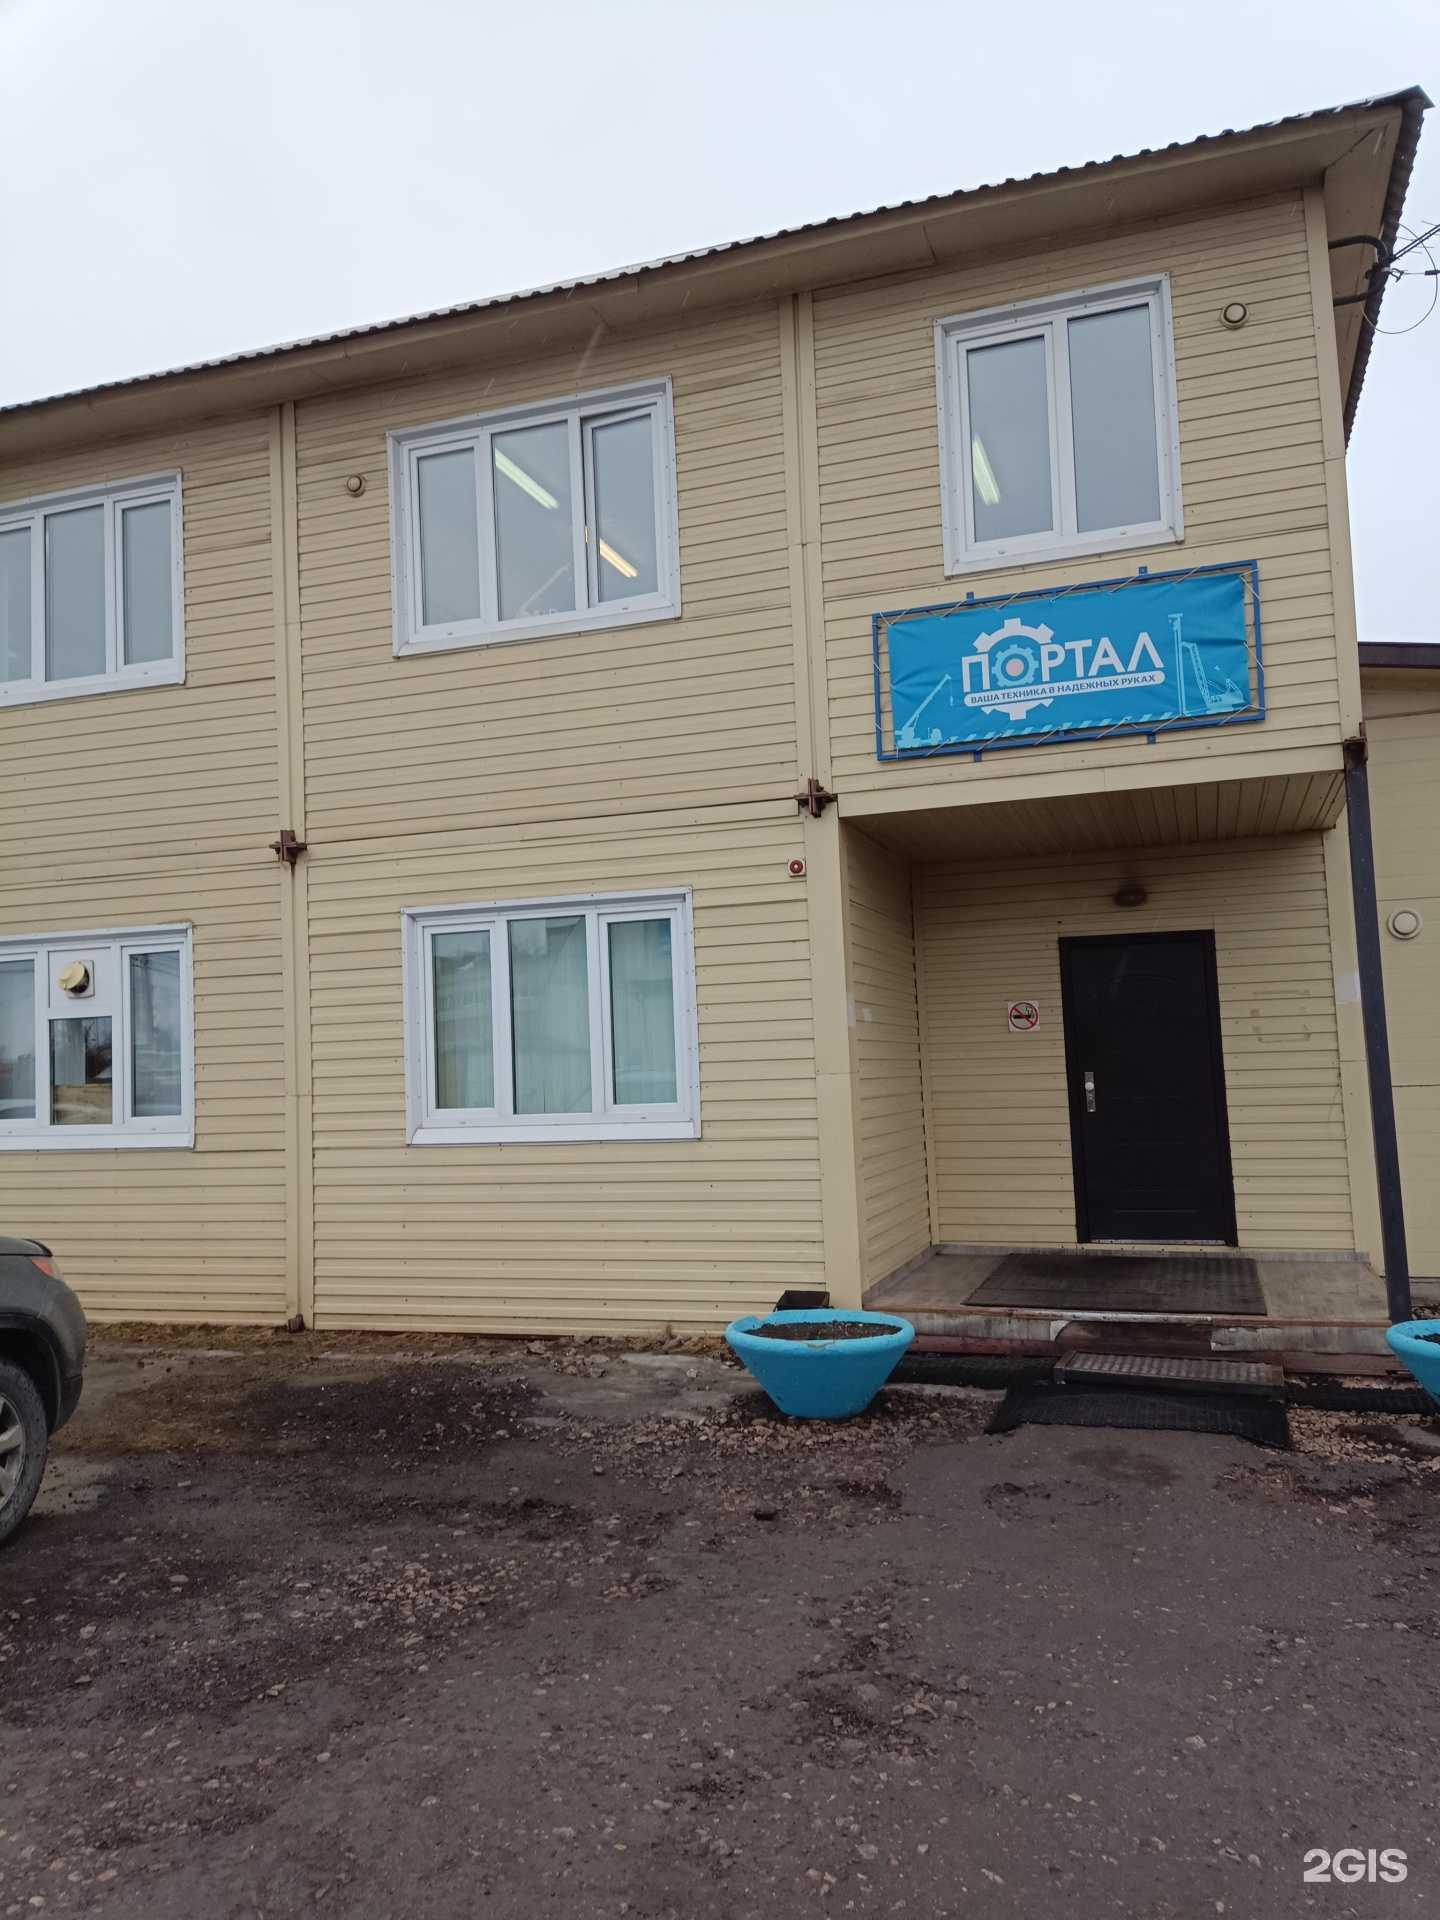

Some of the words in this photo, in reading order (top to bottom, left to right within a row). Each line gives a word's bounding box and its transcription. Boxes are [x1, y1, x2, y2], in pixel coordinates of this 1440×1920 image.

[961, 631, 1164, 692] ПОРТАЛ
[970, 691, 1000, 704] ВАША
[1001, 687, 1047, 700] ТЕХНИКА
[1048, 686, 1055, 694] В
[1057, 680, 1119, 693] НАДЕЖНЫХ
[1121, 675, 1156, 688] РУКАХ
